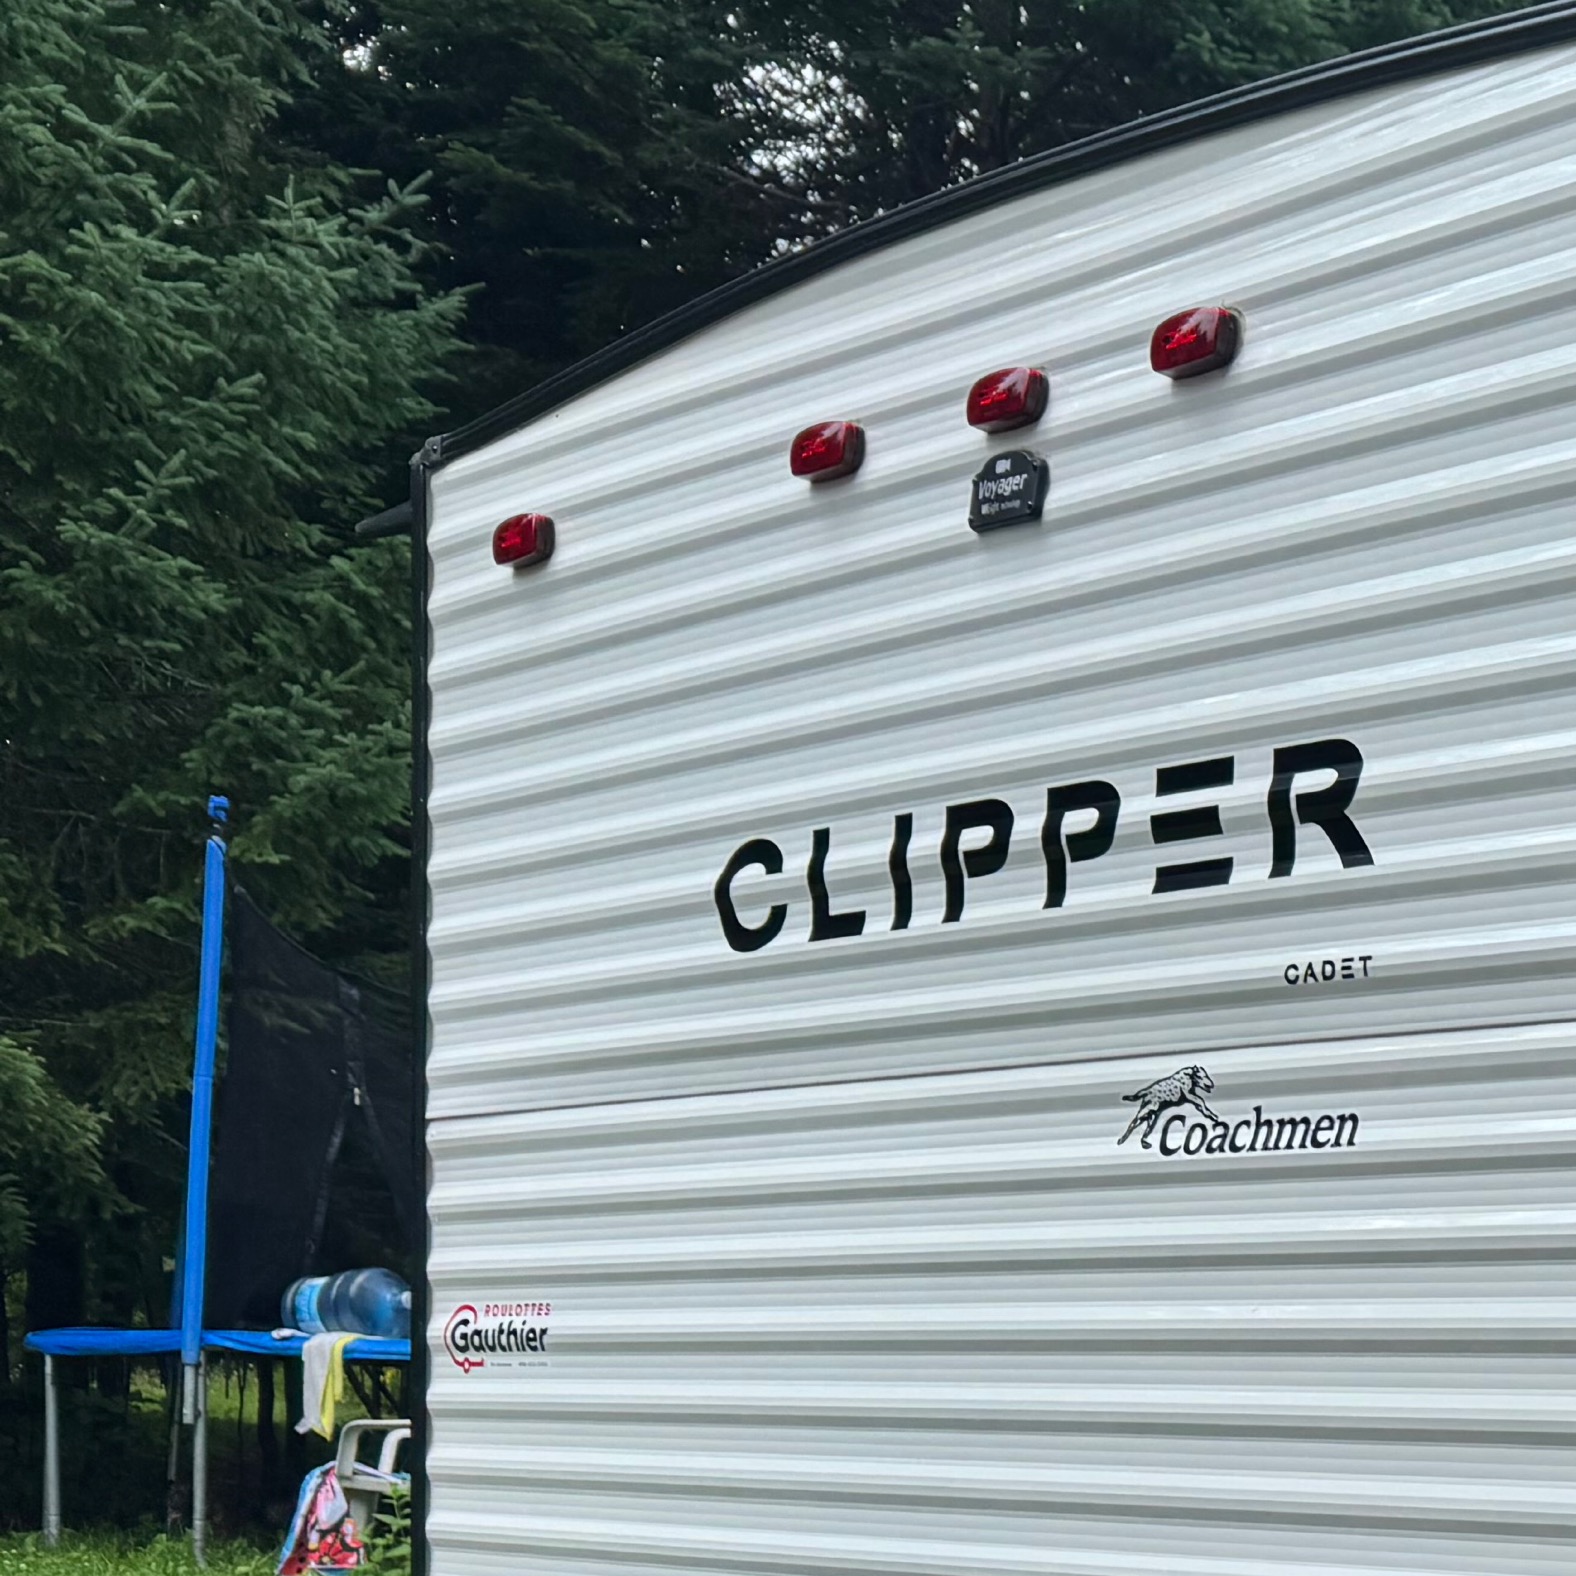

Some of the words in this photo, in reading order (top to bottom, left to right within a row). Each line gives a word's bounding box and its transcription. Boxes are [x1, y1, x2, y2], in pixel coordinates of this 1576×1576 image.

[979, 474, 1028, 500] Voyager
[714, 738, 1375, 952] CLIPPER
[1284, 955, 1373, 985] CADET
[1159, 1105, 1360, 1157] Coachmen
[484, 1303, 552, 1317] ROULOTTES
[450, 1318, 549, 1354] Gauthier
